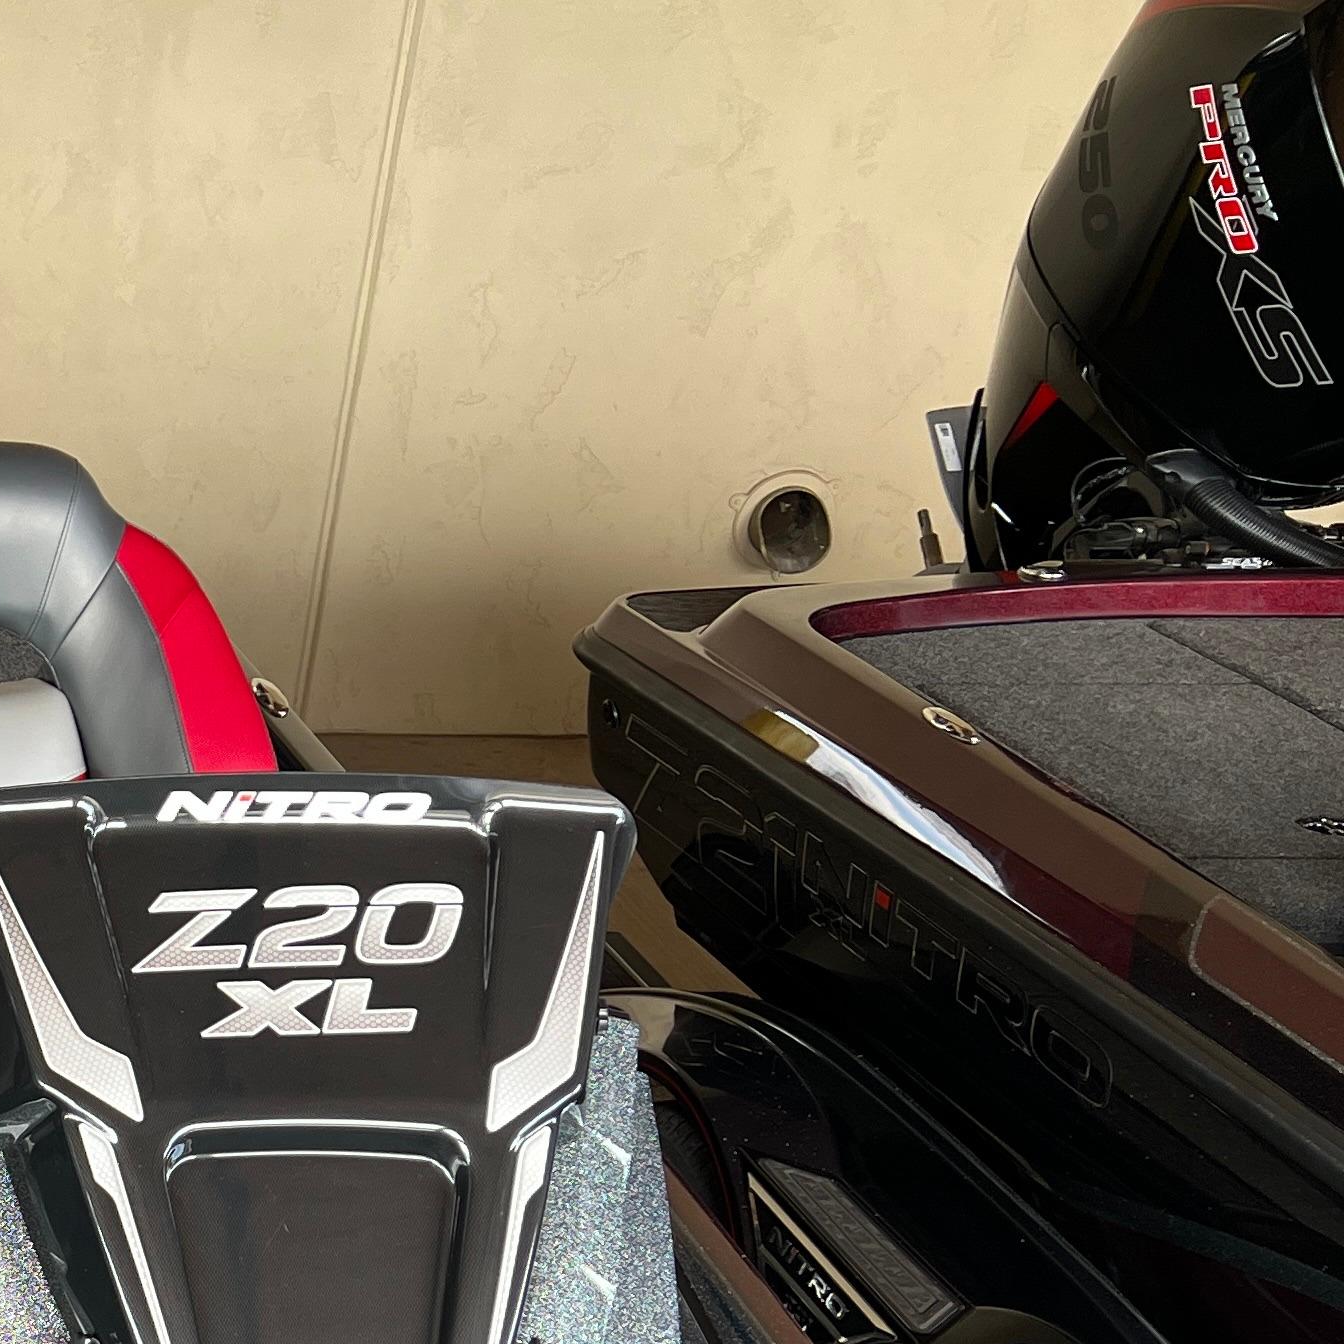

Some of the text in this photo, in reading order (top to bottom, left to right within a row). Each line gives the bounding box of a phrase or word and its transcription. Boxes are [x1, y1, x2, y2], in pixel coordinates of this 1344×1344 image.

[1189, 83, 1259, 254] PRO
[1221, 82, 1279, 221] MERCURY
[156, 790, 432, 824] NITRO
[131, 883, 464, 974] Z20
[200, 978, 418, 1038] XL
